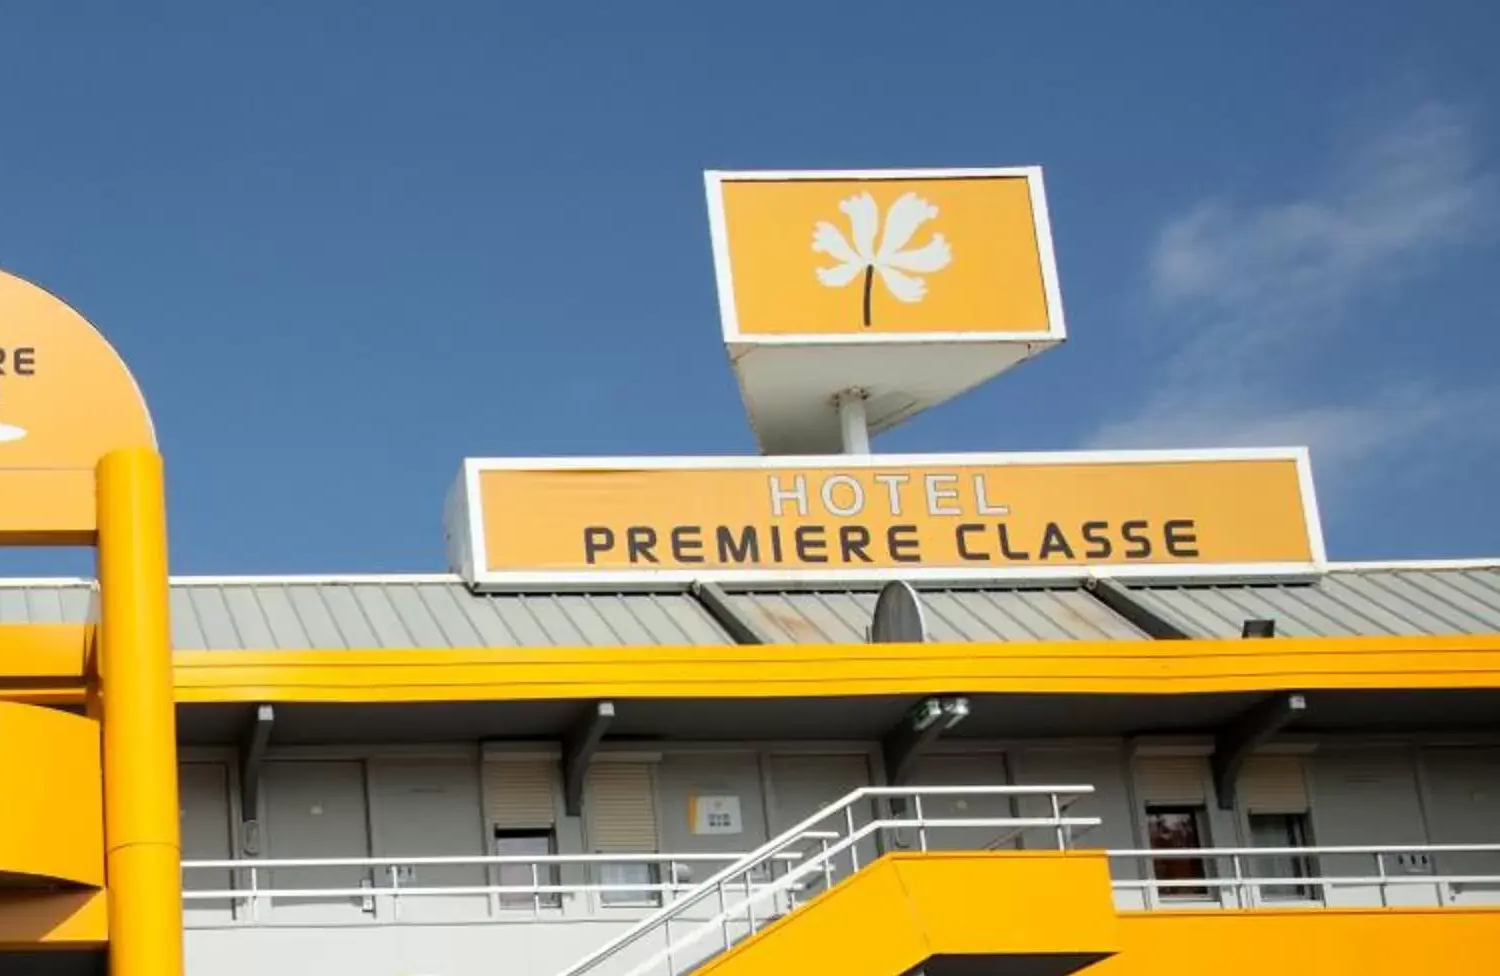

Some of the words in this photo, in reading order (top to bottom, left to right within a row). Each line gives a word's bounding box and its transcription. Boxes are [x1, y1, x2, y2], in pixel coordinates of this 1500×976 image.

[767, 473, 1010, 516] HOTEL
[583, 525, 921, 564] PREMIERE
[955, 519, 1200, 561] CLASSE
